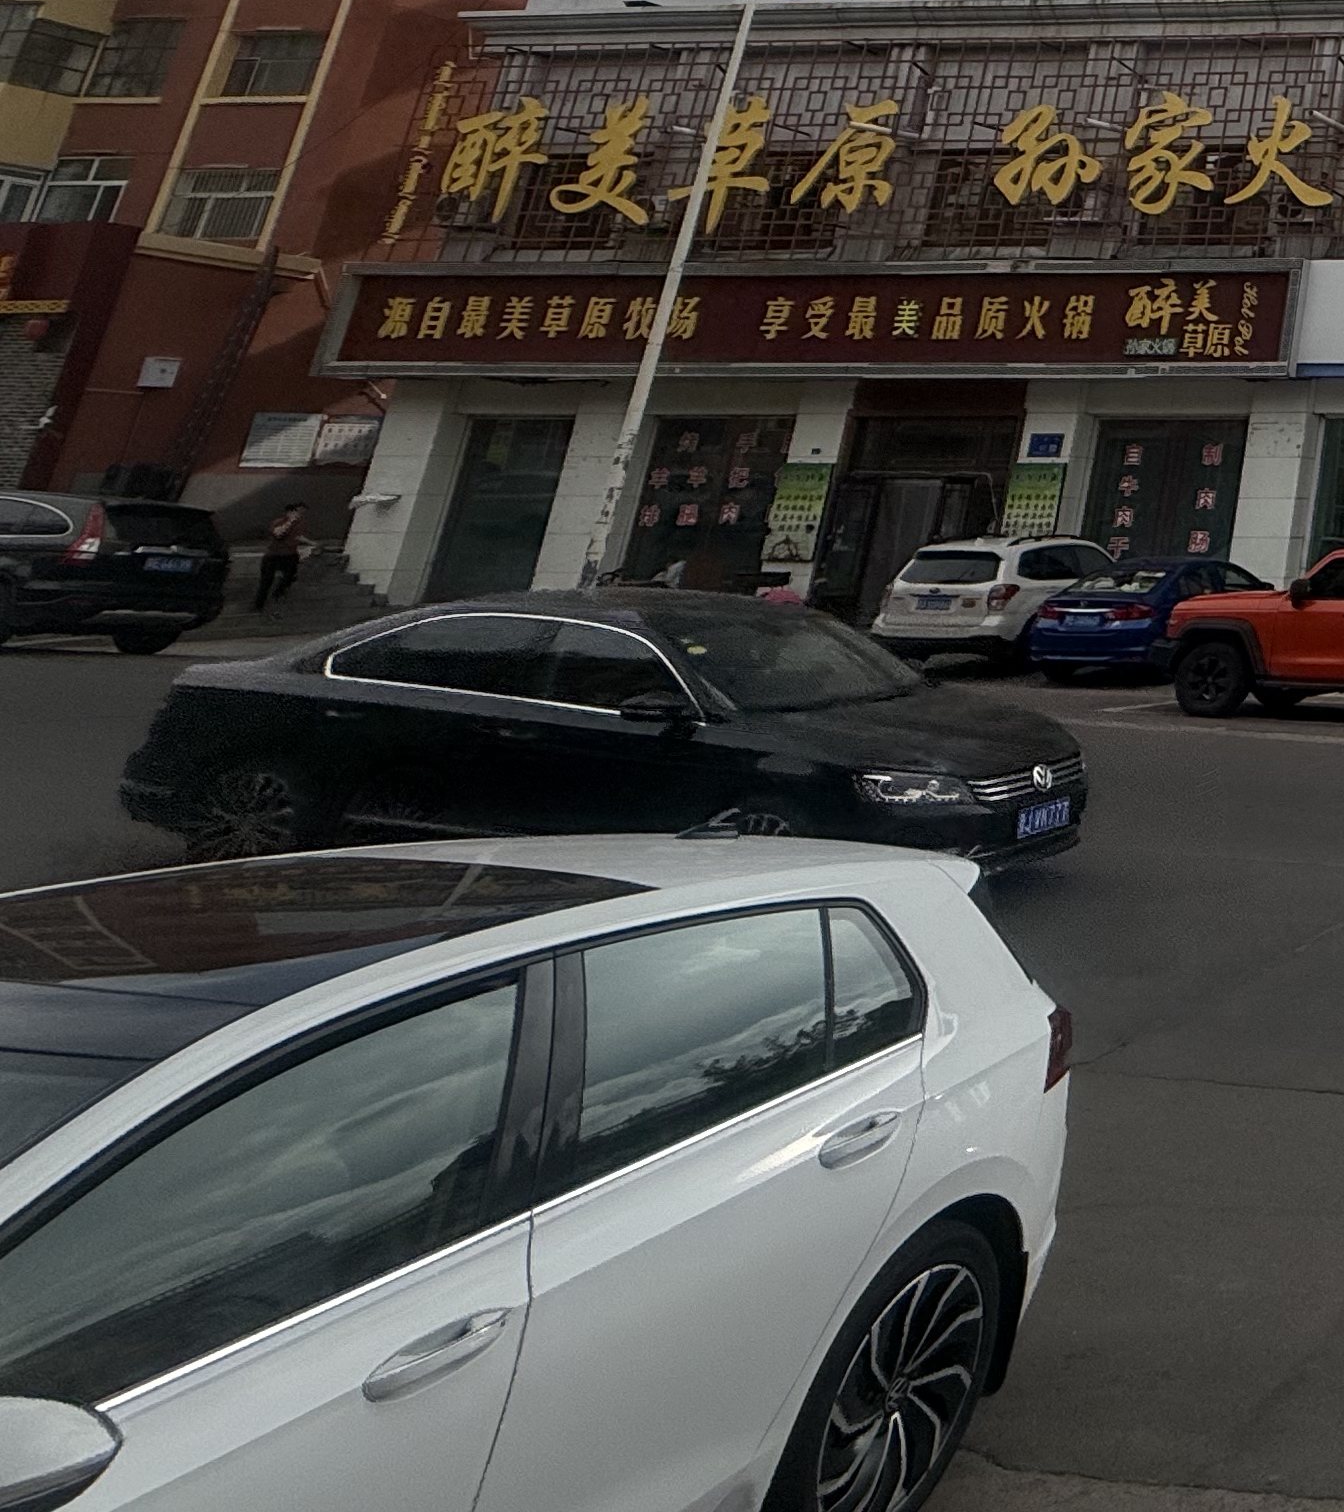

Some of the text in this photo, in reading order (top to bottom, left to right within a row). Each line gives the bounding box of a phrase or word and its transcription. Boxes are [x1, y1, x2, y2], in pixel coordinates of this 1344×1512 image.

[440, 96, 898, 234] 醉美草原
[376, 294, 1096, 340] 源自最美草原牧场 享受最美品质火锅
